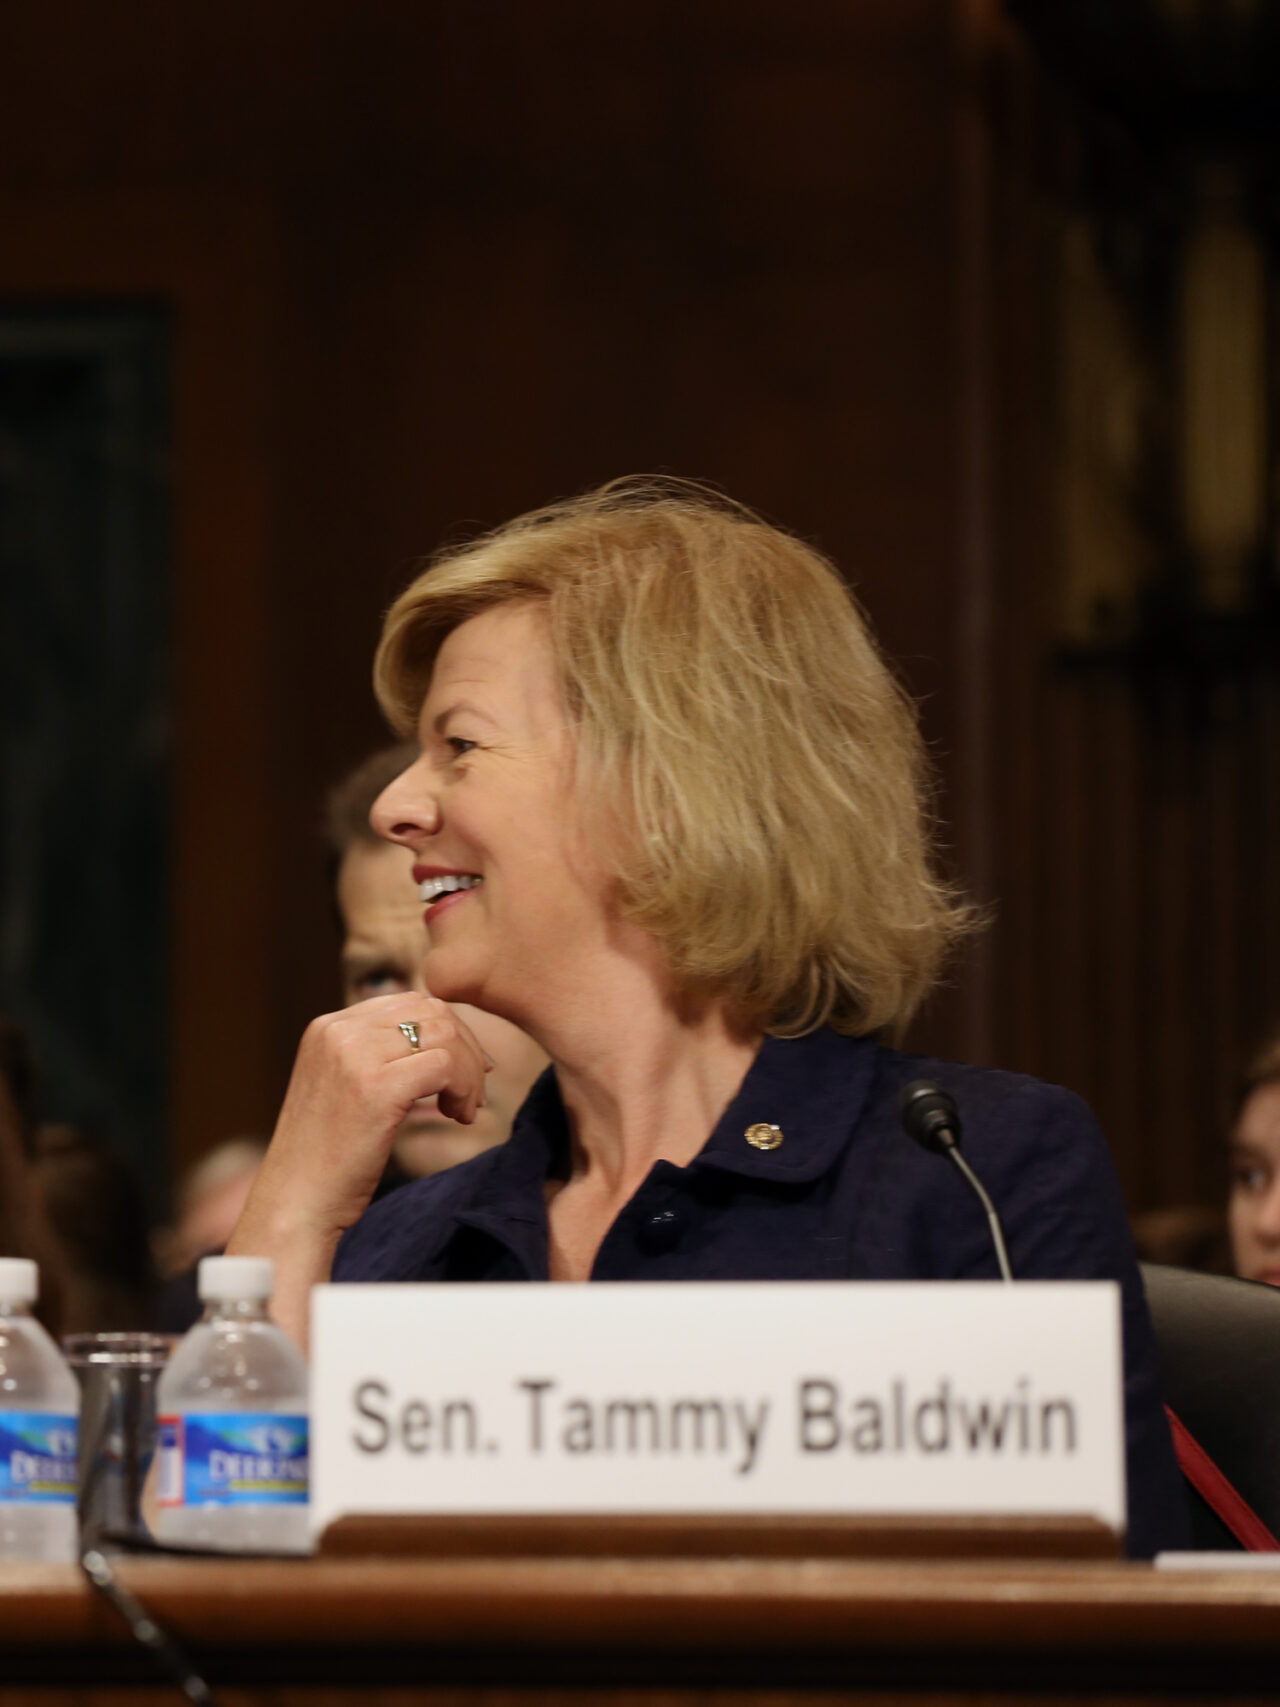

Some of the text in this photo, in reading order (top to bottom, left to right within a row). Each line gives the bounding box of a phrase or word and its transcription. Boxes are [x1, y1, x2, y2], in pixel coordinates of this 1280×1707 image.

[354, 1378, 1077, 1476] Sen. Tammy Baldwin
